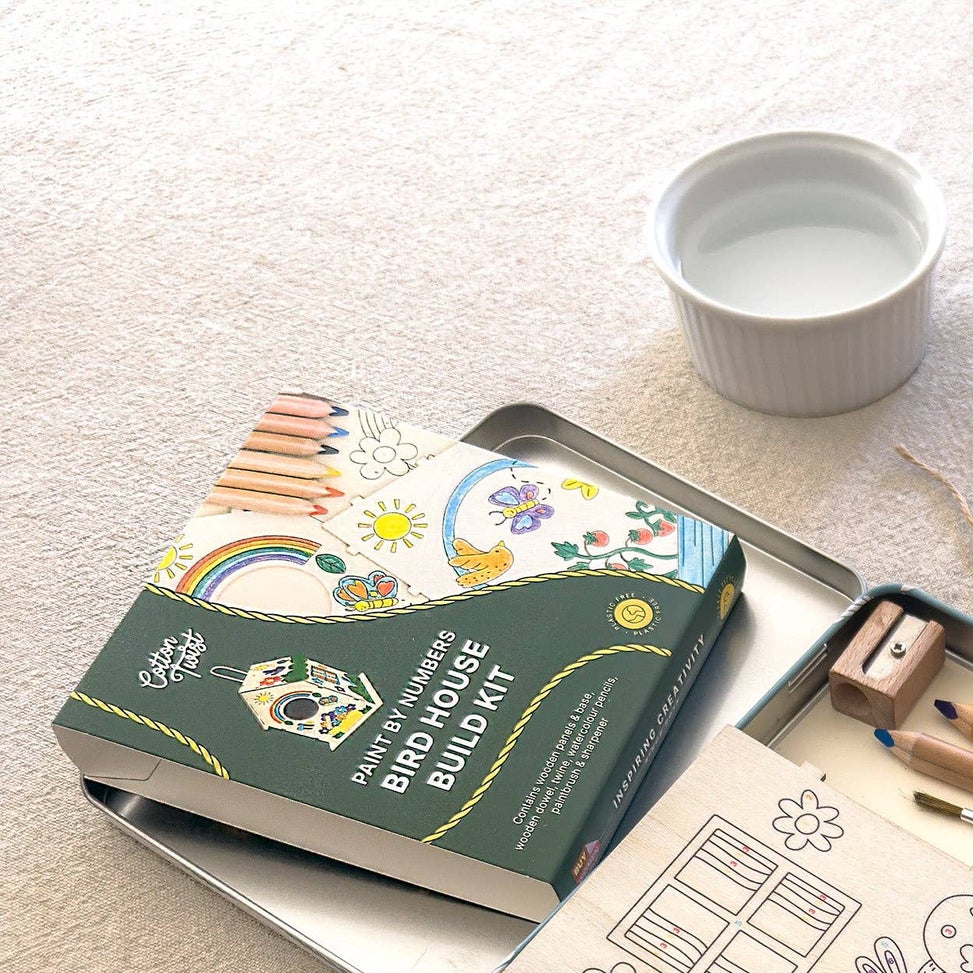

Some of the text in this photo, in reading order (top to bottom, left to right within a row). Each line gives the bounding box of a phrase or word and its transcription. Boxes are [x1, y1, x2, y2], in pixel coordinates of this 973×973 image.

[138, 636, 179, 689] Cotton
[169, 628, 207, 682] Twist
[605, 592, 635, 631] PLASTIC FREE
[633, 597, 662, 636] PLASTIC FREE
[351, 630, 456, 786] PAINT BY NUMBERS
[380, 639, 490, 794] BIRD HOUSE
[426, 664, 516, 791] BUILD KIT
[512, 691, 596, 826] Contains wooden panels & base,
[515, 675, 619, 852] wooden dowel, twine, watercolour pencils,
[551, 768, 582, 816] paintbrush
[581, 717, 609, 761] sharpener
[612, 728, 656, 809] INSPIRING
[656, 633, 706, 726] CREATIVITY
